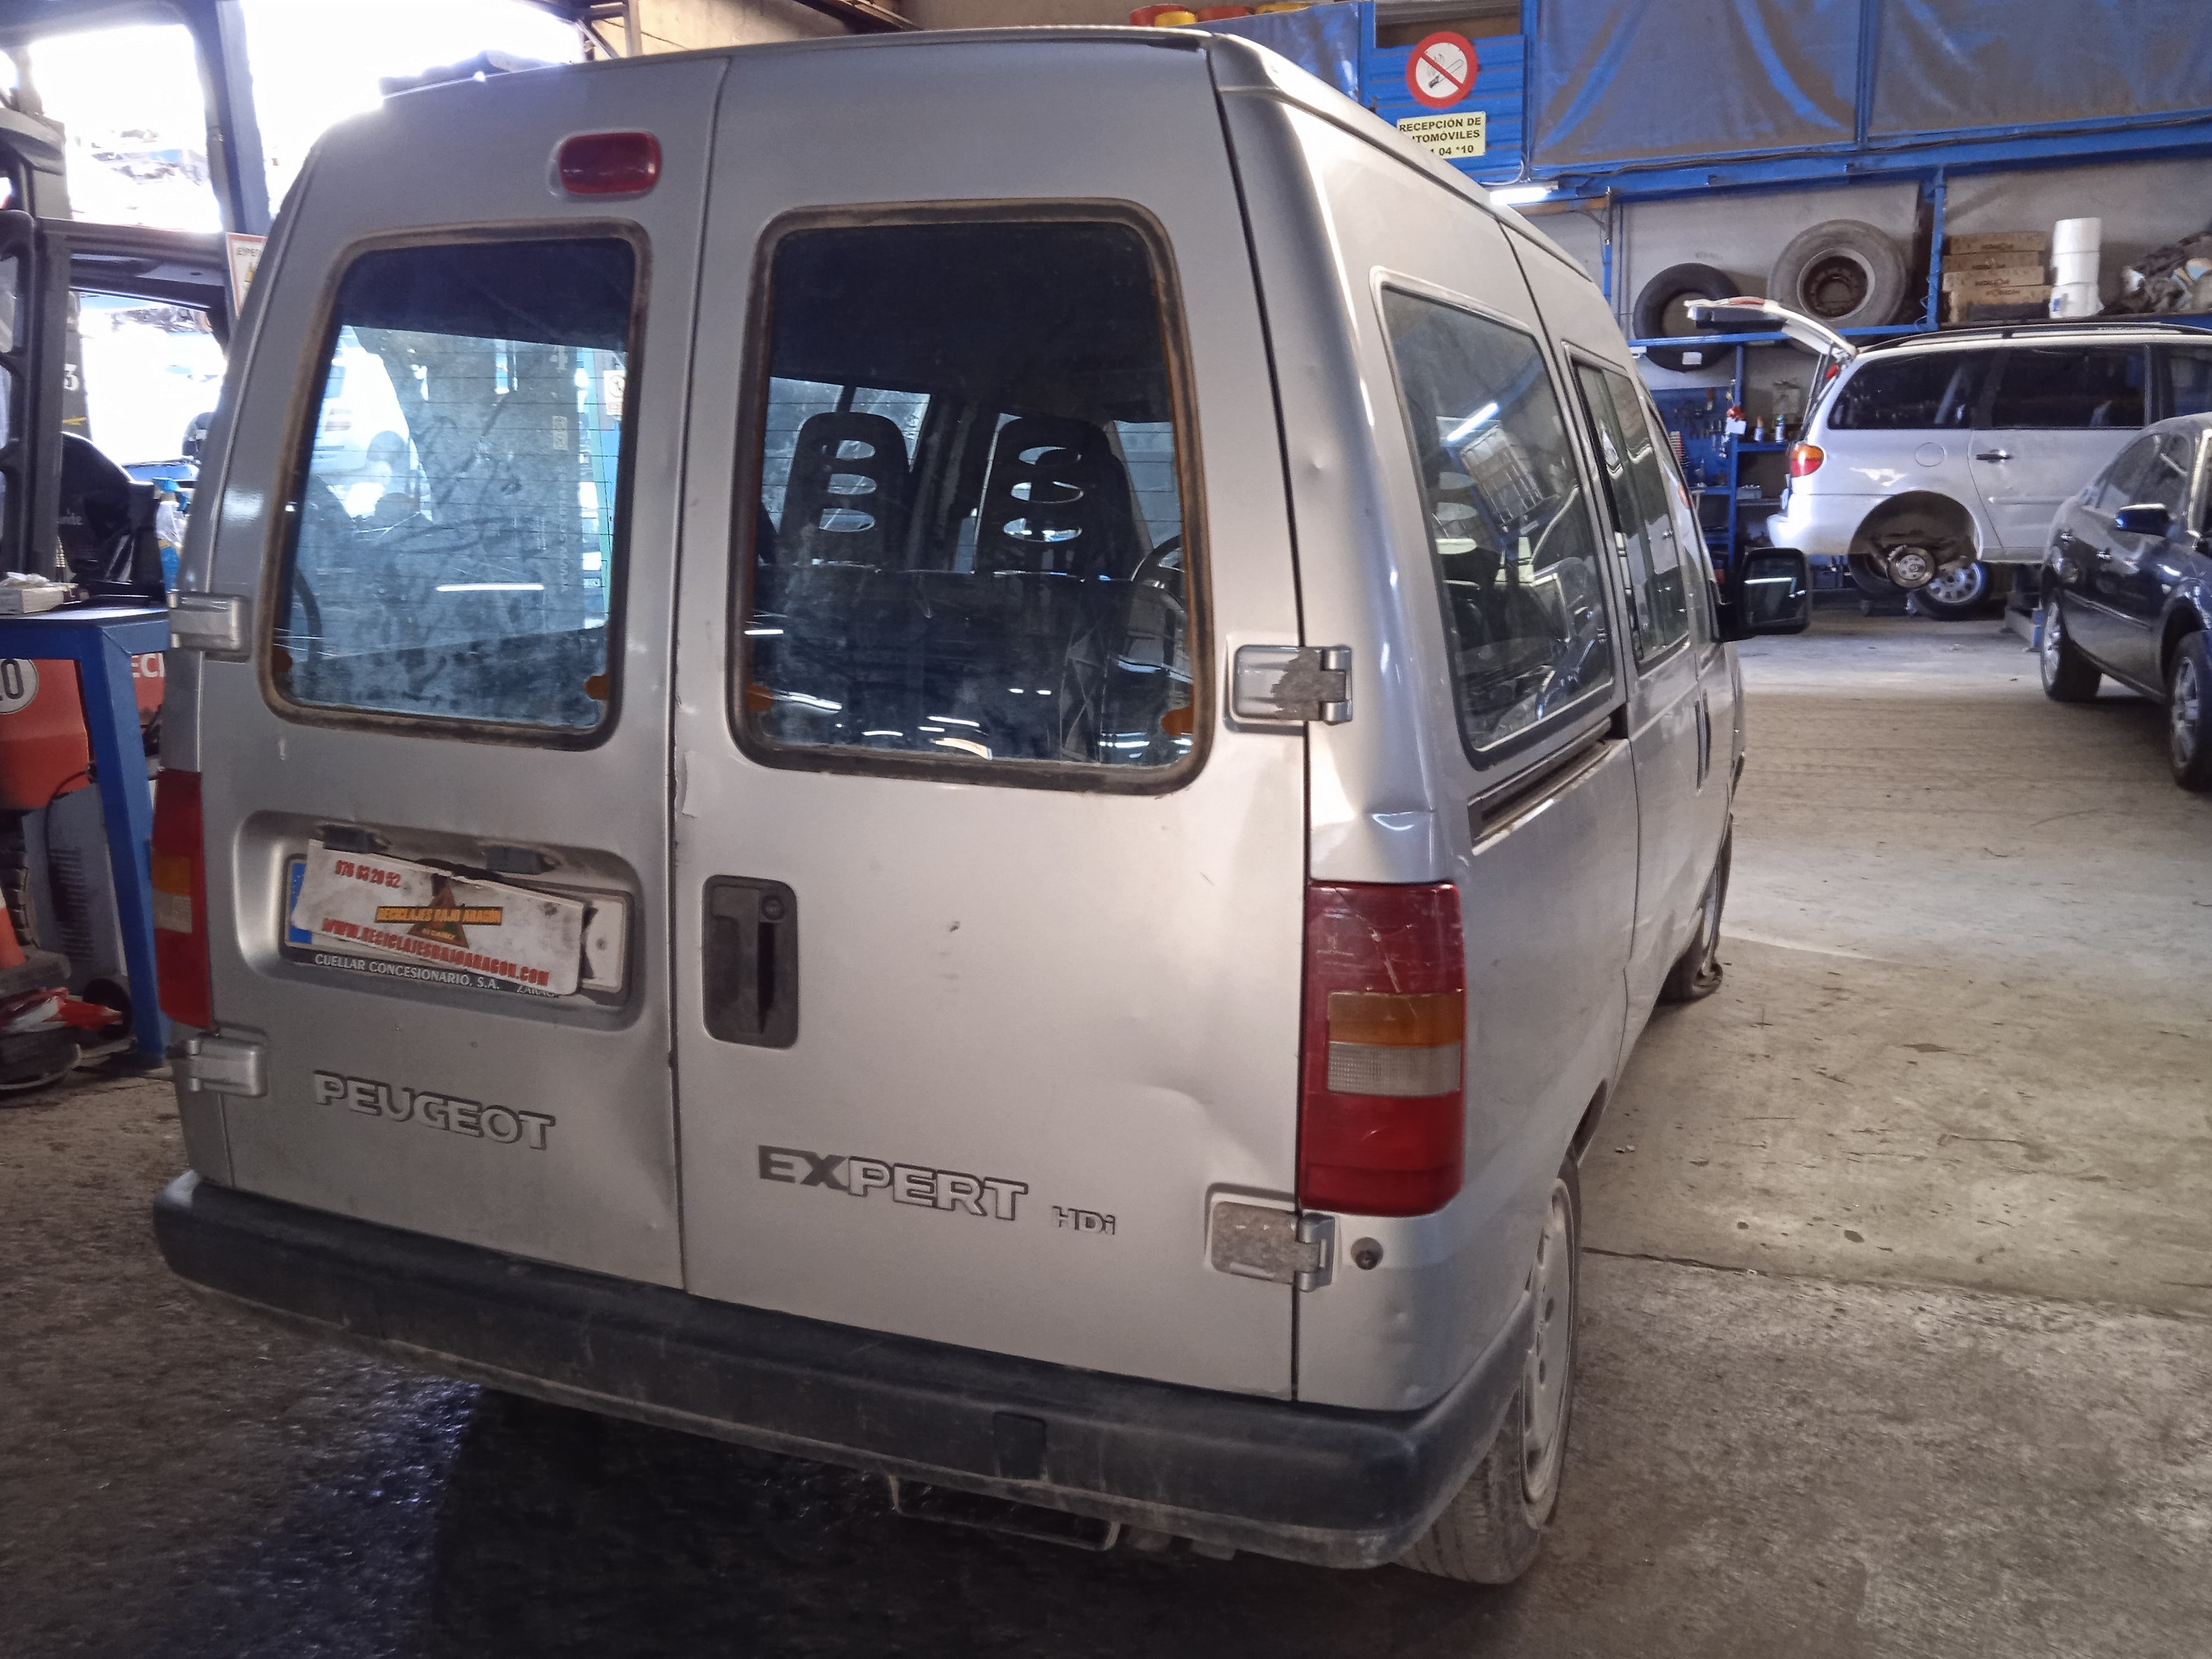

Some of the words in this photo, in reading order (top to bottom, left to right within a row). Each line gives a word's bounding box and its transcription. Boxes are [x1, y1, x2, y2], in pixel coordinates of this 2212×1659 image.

[1399, 118, 1463, 132] RECEPCIÓN
[1467, 117, 1482, 126] DE
[1412, 130, 1480, 143] TOMÓVILES
[315, 953, 365, 971] CUELLAR
[476, 976, 500, 990] S.A.
[313, 1069, 556, 1151] PEUGEOT
[758, 1145, 1029, 1222] EXPERT
[1051, 1206, 1116, 1236] HDi
